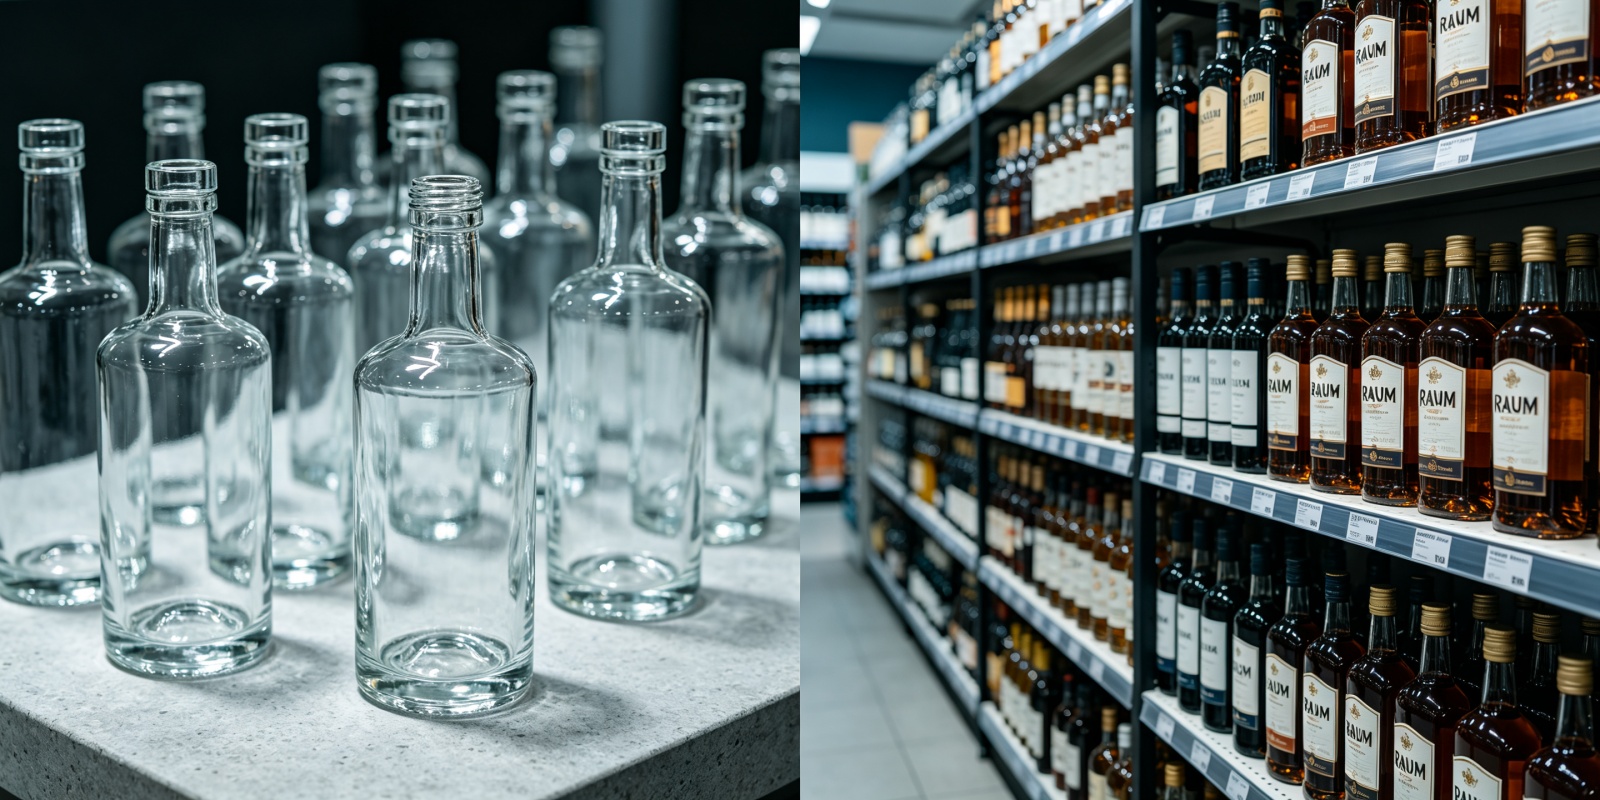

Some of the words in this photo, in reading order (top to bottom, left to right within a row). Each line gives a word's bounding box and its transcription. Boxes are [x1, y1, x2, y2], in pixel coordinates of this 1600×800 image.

[1439, 6, 1480, 34] RAUM
[1355, 40, 1387, 65] RAUM
[1268, 378, 1292, 394] RAUM
[1311, 381, 1340, 399] RAUM
[1362, 385, 1397, 404] RAUM
[1419, 388, 1456, 408] RAUM
[1494, 394, 1539, 416] RAUM
[1395, 750, 1426, 780] RAUM
